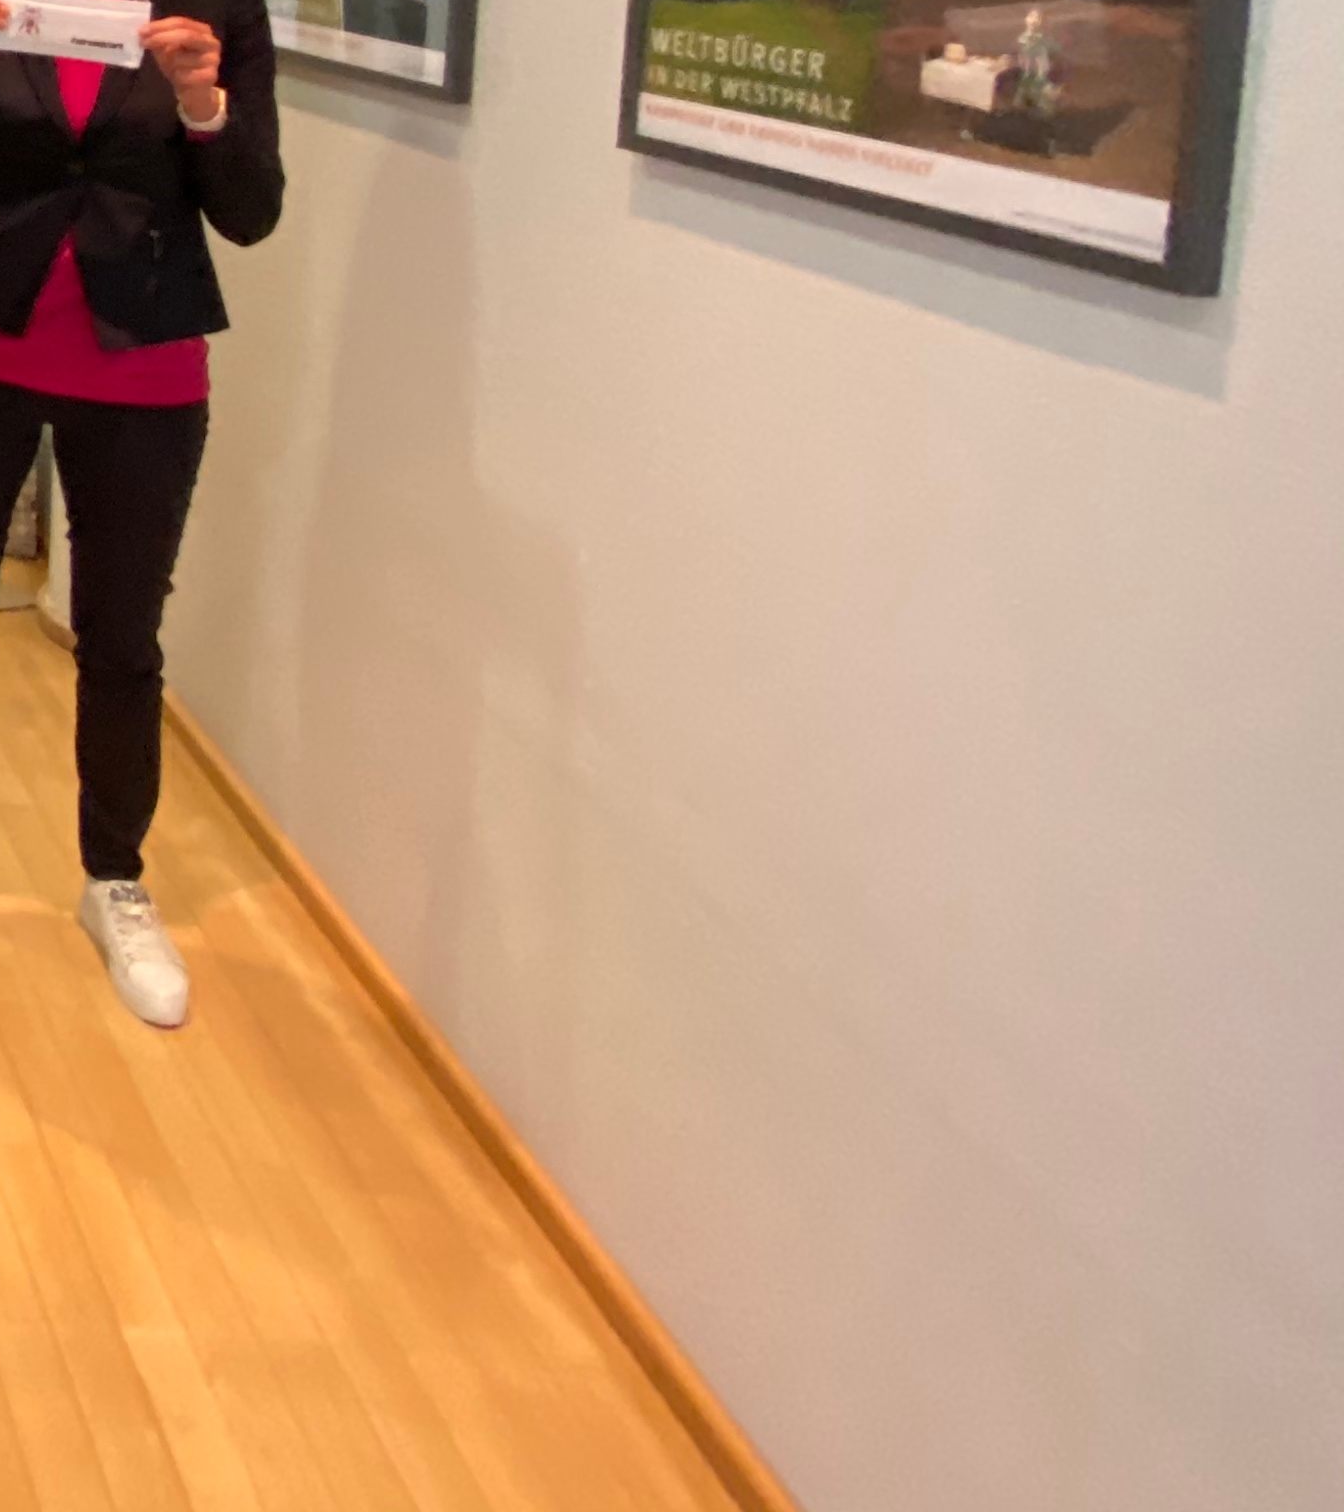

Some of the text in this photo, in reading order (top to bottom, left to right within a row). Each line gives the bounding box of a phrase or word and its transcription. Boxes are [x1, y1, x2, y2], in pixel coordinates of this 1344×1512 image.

[650, 27, 826, 81] WELTBÜRGER
[673, 69, 713, 94] DER
[719, 75, 854, 123] WESTPFALZ
